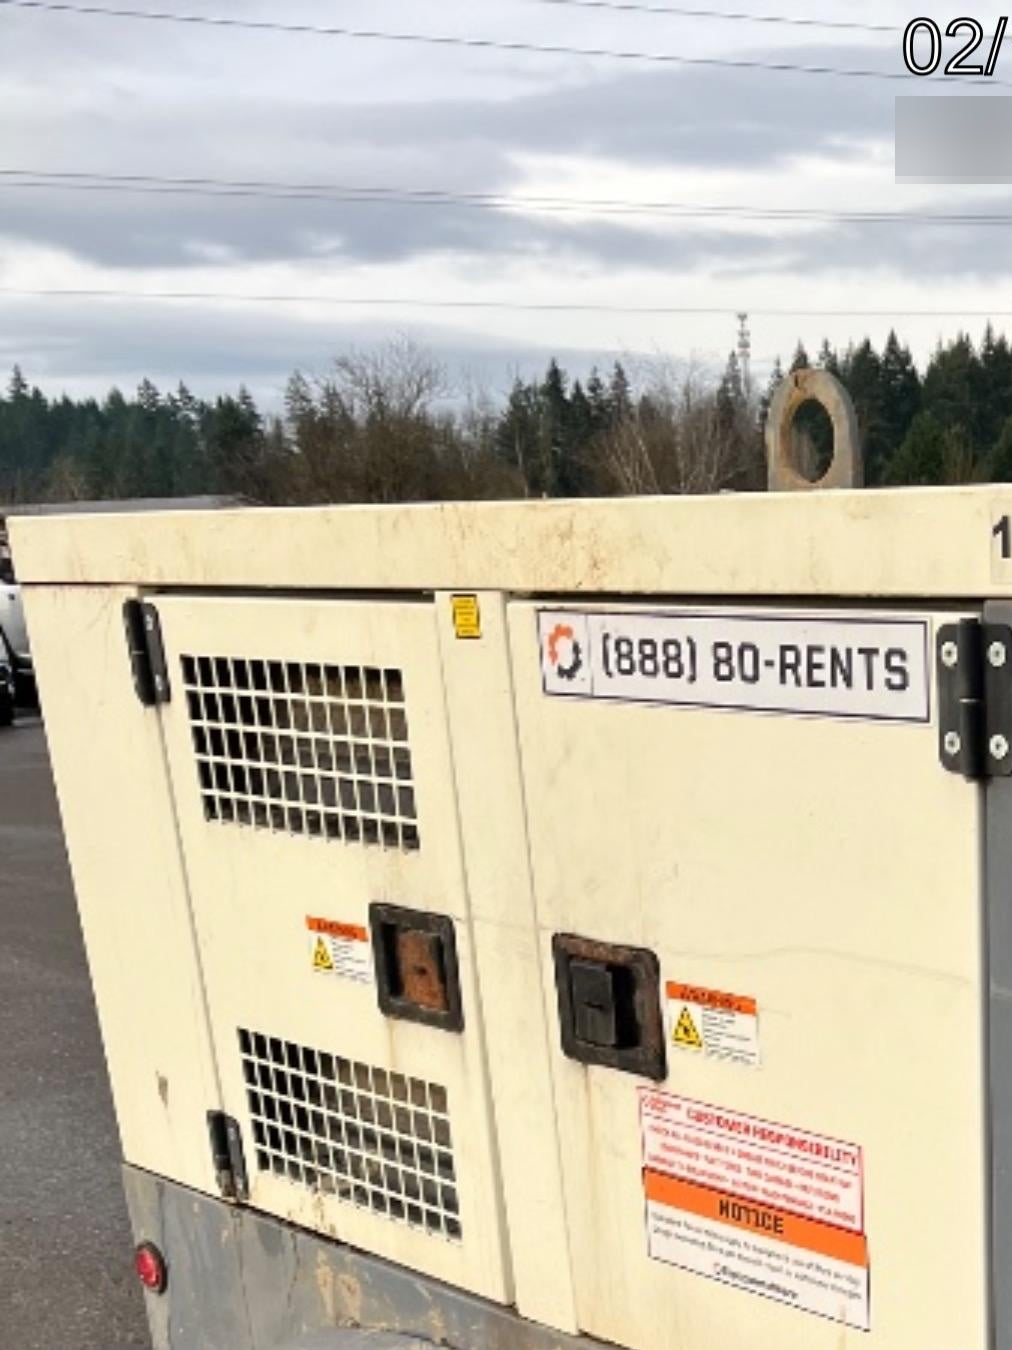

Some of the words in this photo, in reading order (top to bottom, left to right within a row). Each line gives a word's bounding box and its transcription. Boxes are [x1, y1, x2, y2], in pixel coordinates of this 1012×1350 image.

[602, 632, 697, 683] (888)
[712, 641, 910, 691] 80-RENTS
[718, 1198, 785, 1235] NOTICE
